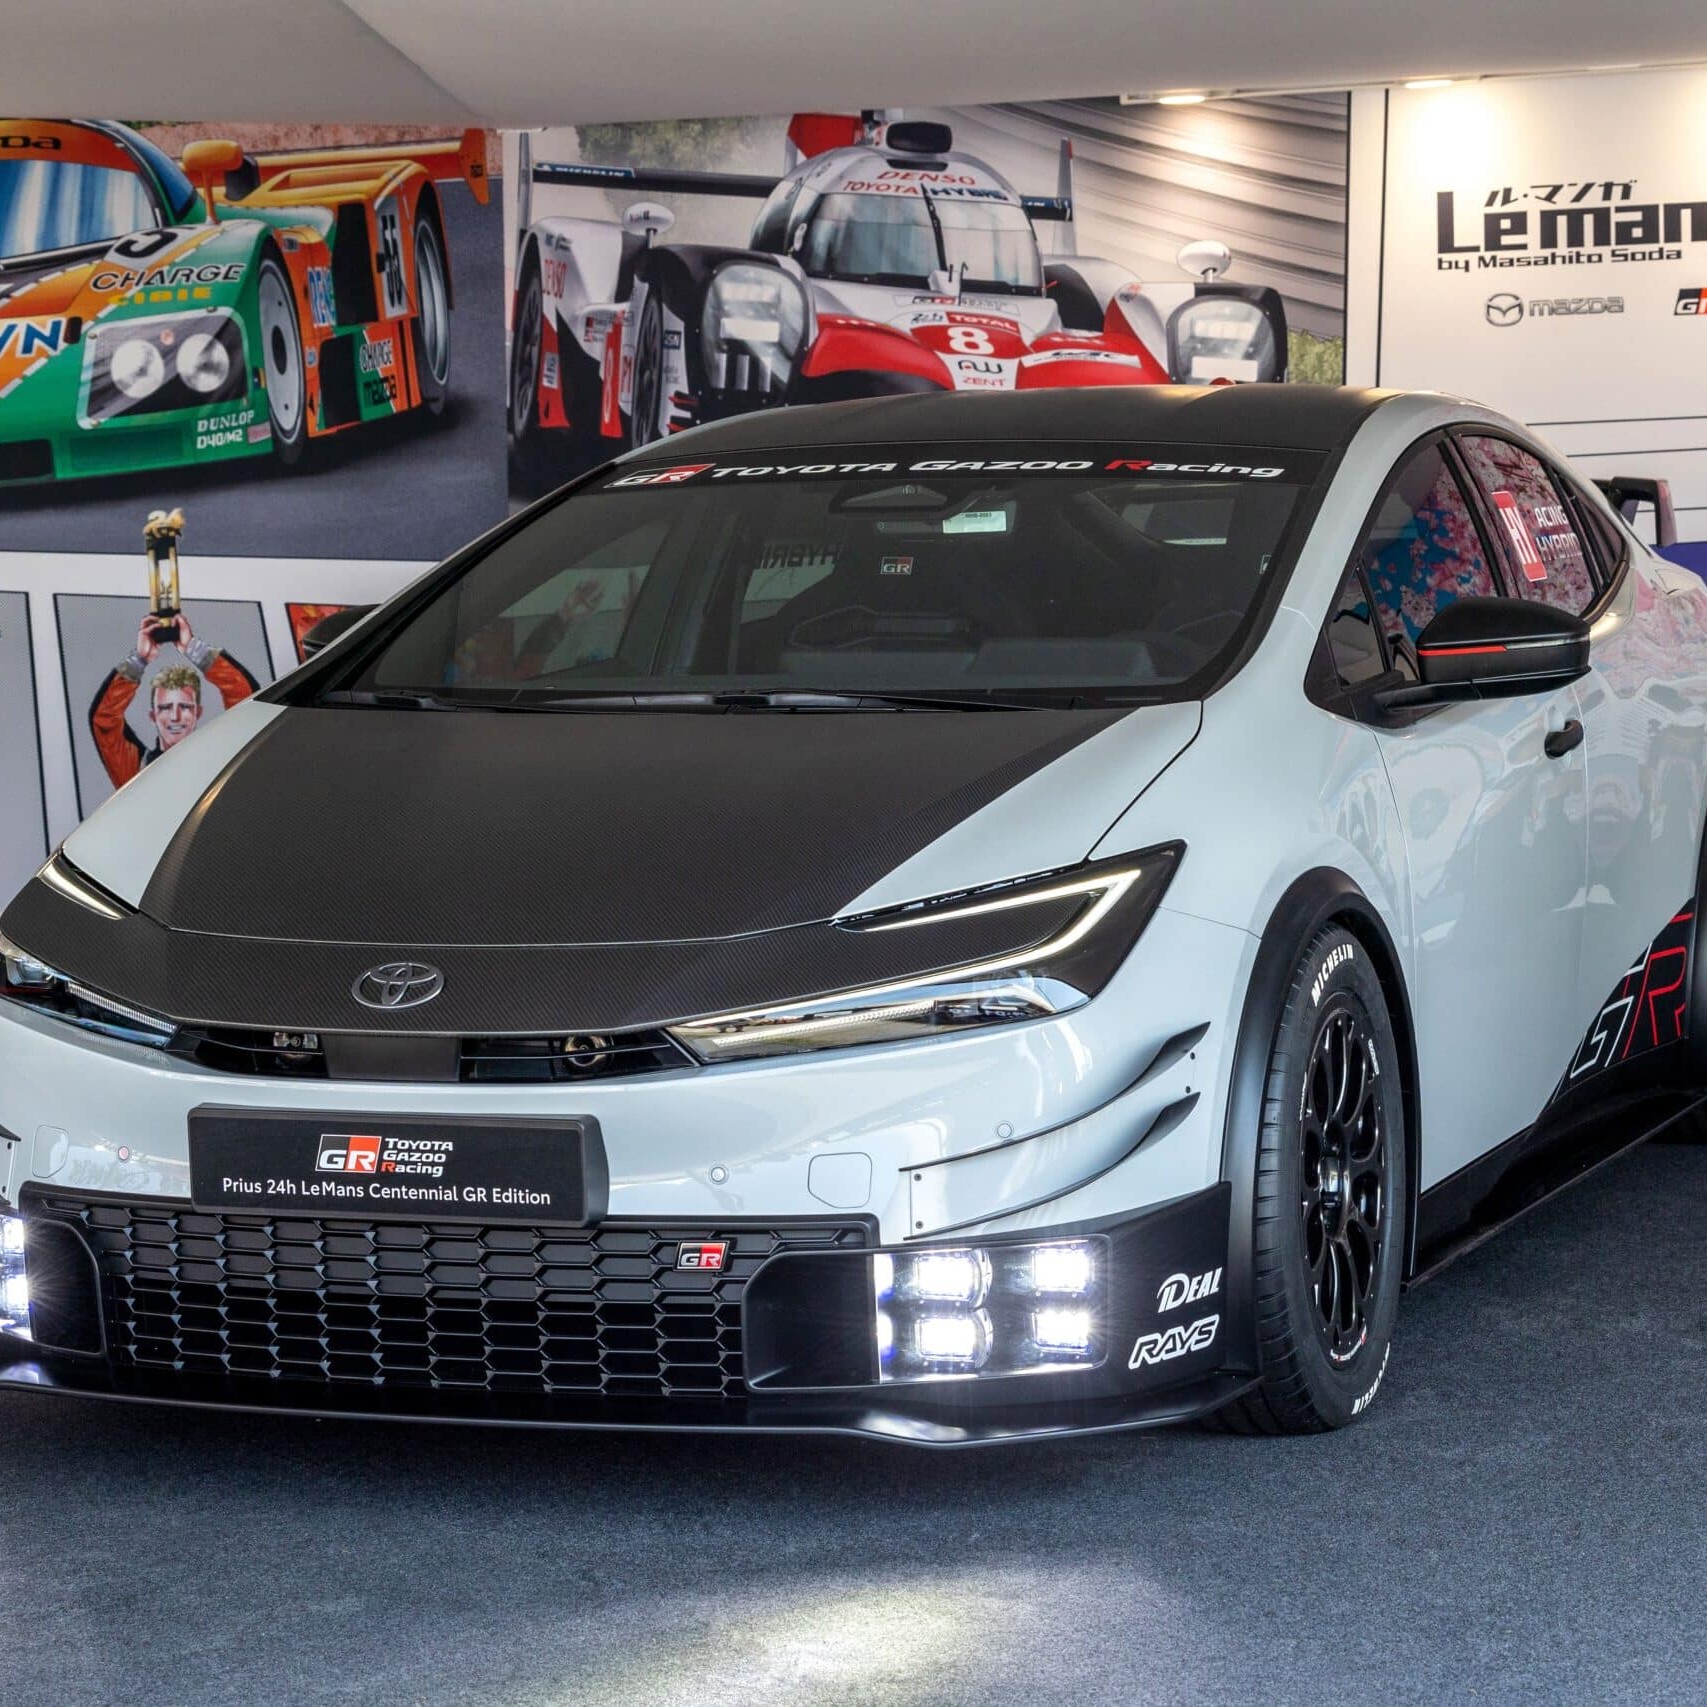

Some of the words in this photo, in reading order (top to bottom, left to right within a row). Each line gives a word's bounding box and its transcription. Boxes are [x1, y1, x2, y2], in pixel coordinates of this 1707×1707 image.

[843, 181, 919, 195] TOYOTA
[877, 171, 976, 185] DENSO
[1437, 256, 1470, 273] by
[1478, 250, 1603, 269] Masahito
[1610, 247, 1683, 263] Soda
[91, 264, 245, 291] CHARGE
[1529, 296, 1625, 317] mazda
[949, 313, 1017, 330] TOTAL
[948, 327, 995, 355] 8
[963, 378, 1006, 387] ZENT
[197, 410, 254, 432] DUNLOP
[711, 463, 897, 478] TOYOTA
[909, 460, 1093, 471] GAZOO
[1104, 459, 1284, 478] Racing
[1311, 943, 1353, 1007] MICHELIN
[385, 1138, 453, 1151] TOYOTA
[320, 1148, 376, 1171] GR
[384, 1151, 446, 1163] GAZOO
[382, 1162, 443, 1177] Racing
[223, 1178, 262, 1193] Prius
[266, 1179, 296, 1195] 24h
[370, 1184, 458, 1202] Centennial
[463, 1188, 488, 1203] GR
[493, 1188, 550, 1206] Edition
[680, 1253, 720, 1266] GR
[1128, 1314, 1220, 1370] RAYS
